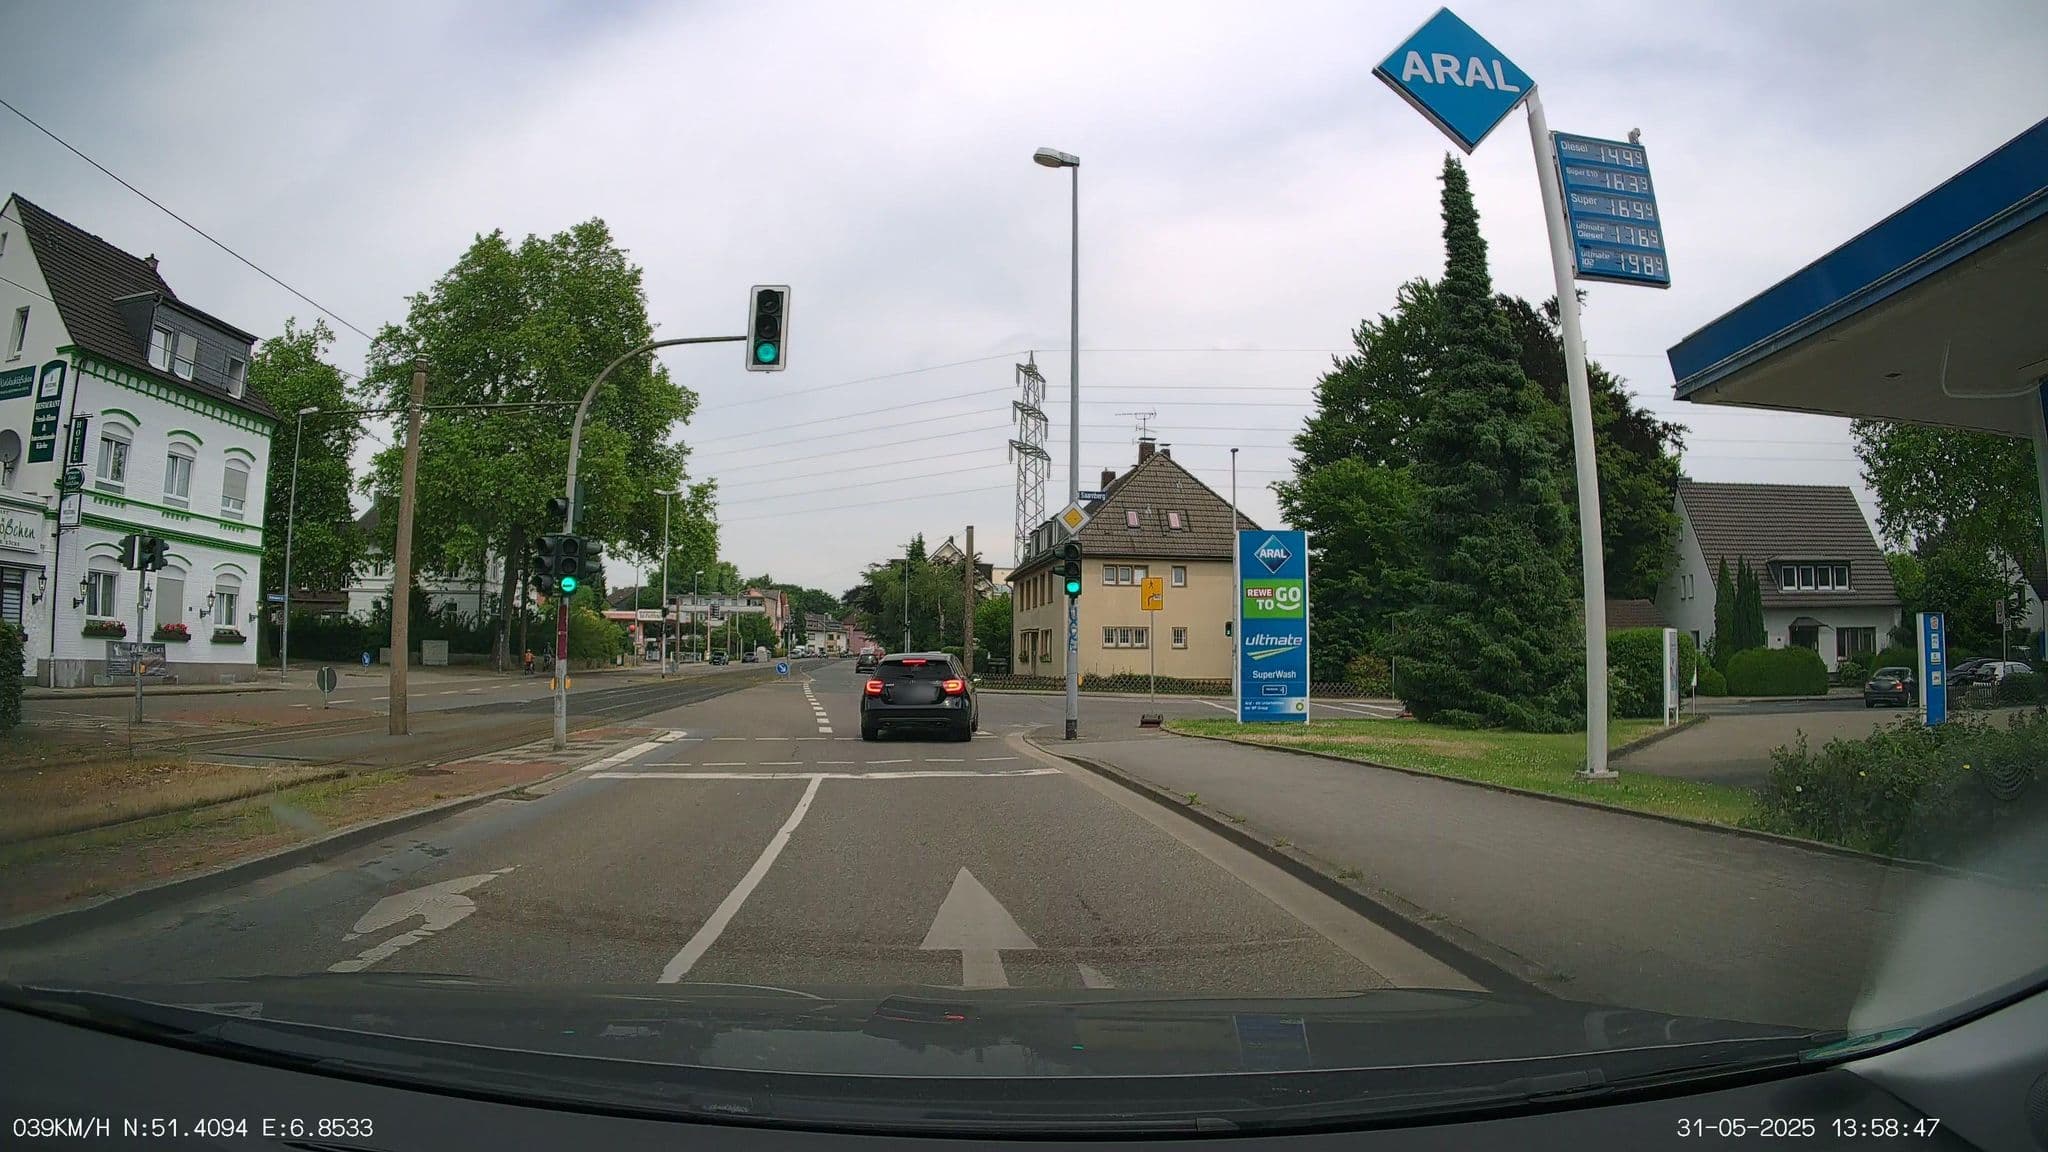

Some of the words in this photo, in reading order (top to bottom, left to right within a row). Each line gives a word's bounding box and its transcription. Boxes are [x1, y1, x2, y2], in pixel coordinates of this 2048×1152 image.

[1402, 50, 1520, 93] ARAL
[1561, 140, 1588, 153] Diesel
[1571, 193, 1598, 206] Super
[1577, 230, 1603, 240] Diesel
[73, 421, 82, 461] HOTEL
[1260, 549, 1287, 558] ARAL
[1247, 588, 1273, 597] REWE
[1275, 586, 1301, 602] GO
[1256, 599, 1274, 610] TO
[1245, 634, 1303, 646] ultimate
[1252, 670, 1297, 680] SuperWash
